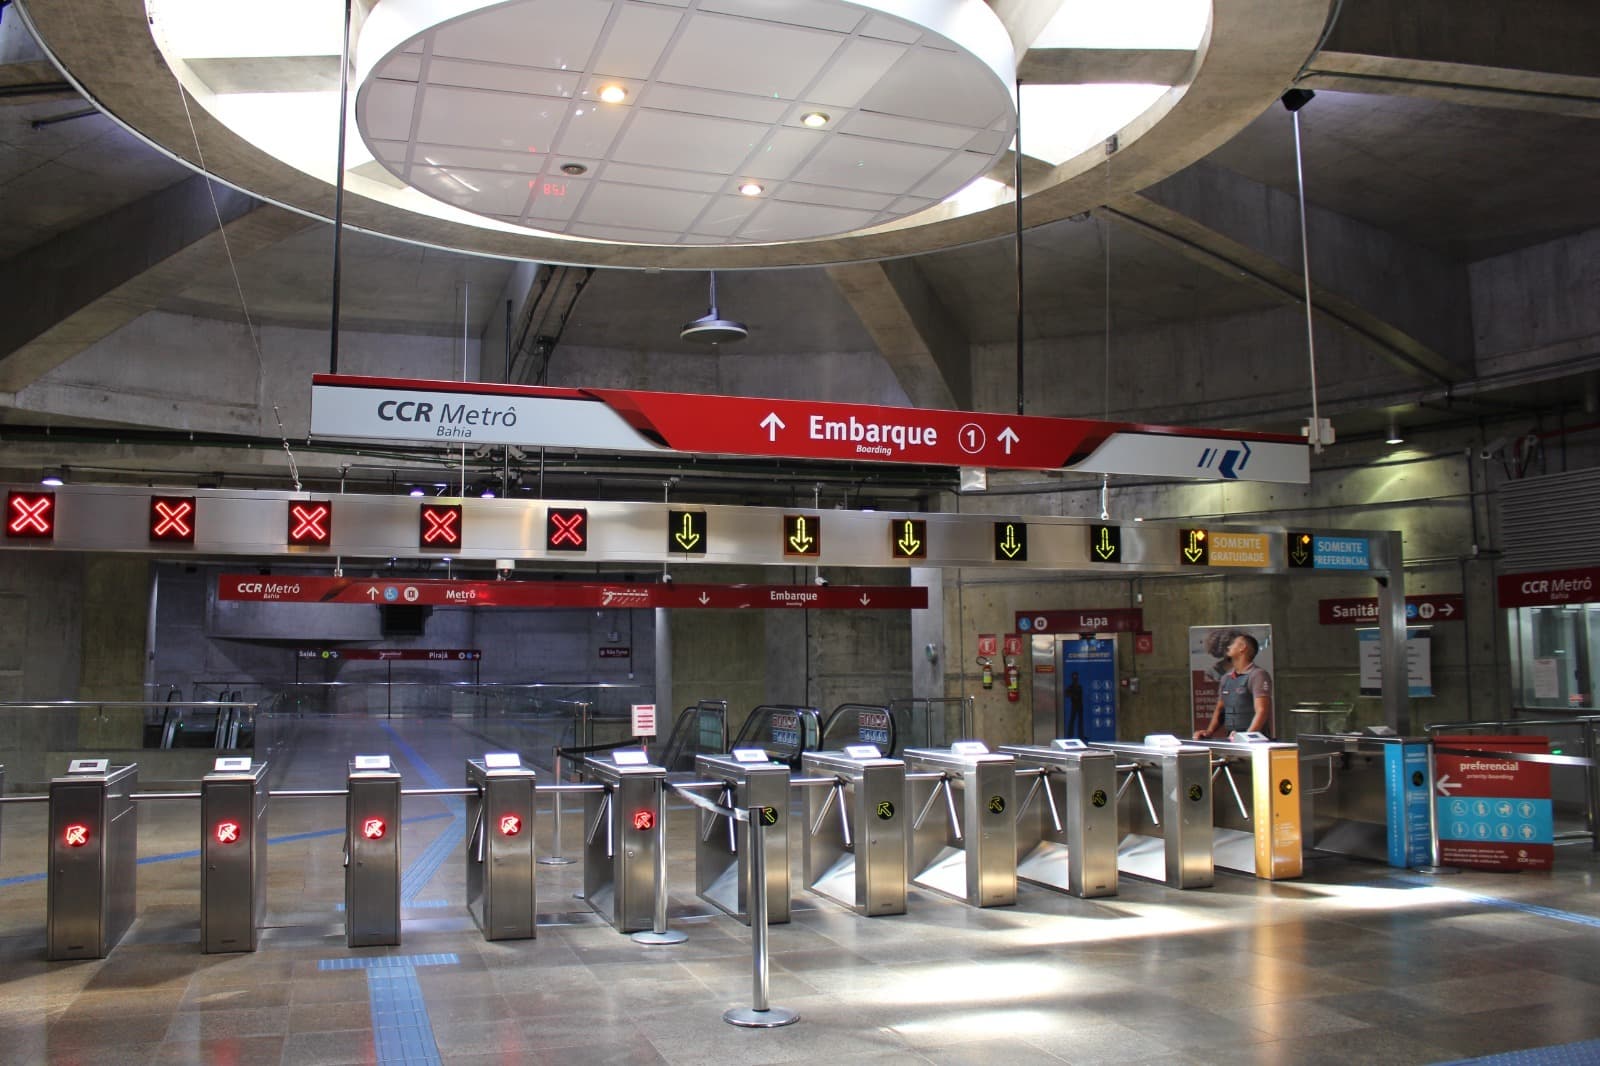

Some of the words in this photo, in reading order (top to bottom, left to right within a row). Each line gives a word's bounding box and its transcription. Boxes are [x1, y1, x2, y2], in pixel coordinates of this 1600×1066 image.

[377, 399, 434, 423] CCR
[439, 403, 517, 428] Metrô
[436, 425, 473, 439] Bahia
[809, 414, 938, 450] Embarque
[856, 445, 892, 457] Boarding
[1213, 536, 1262, 549] SOMENTE
[1317, 541, 1363, 553] SOMENTE
[1210, 551, 1265, 562] GRATUIDADE
[237, 583, 263, 593] CCR
[265, 583, 301, 594] Metrô
[1521, 580, 1549, 594] CCR
[1551, 576, 1593, 592] Metrô
[446, 589, 476, 599] Metrô
[770, 590, 818, 603] Embarque
[1080, 615, 1108, 628] Lapa
[429, 651, 448, 659] Pirajá
[1460, 761, 1519, 772] preferencial
